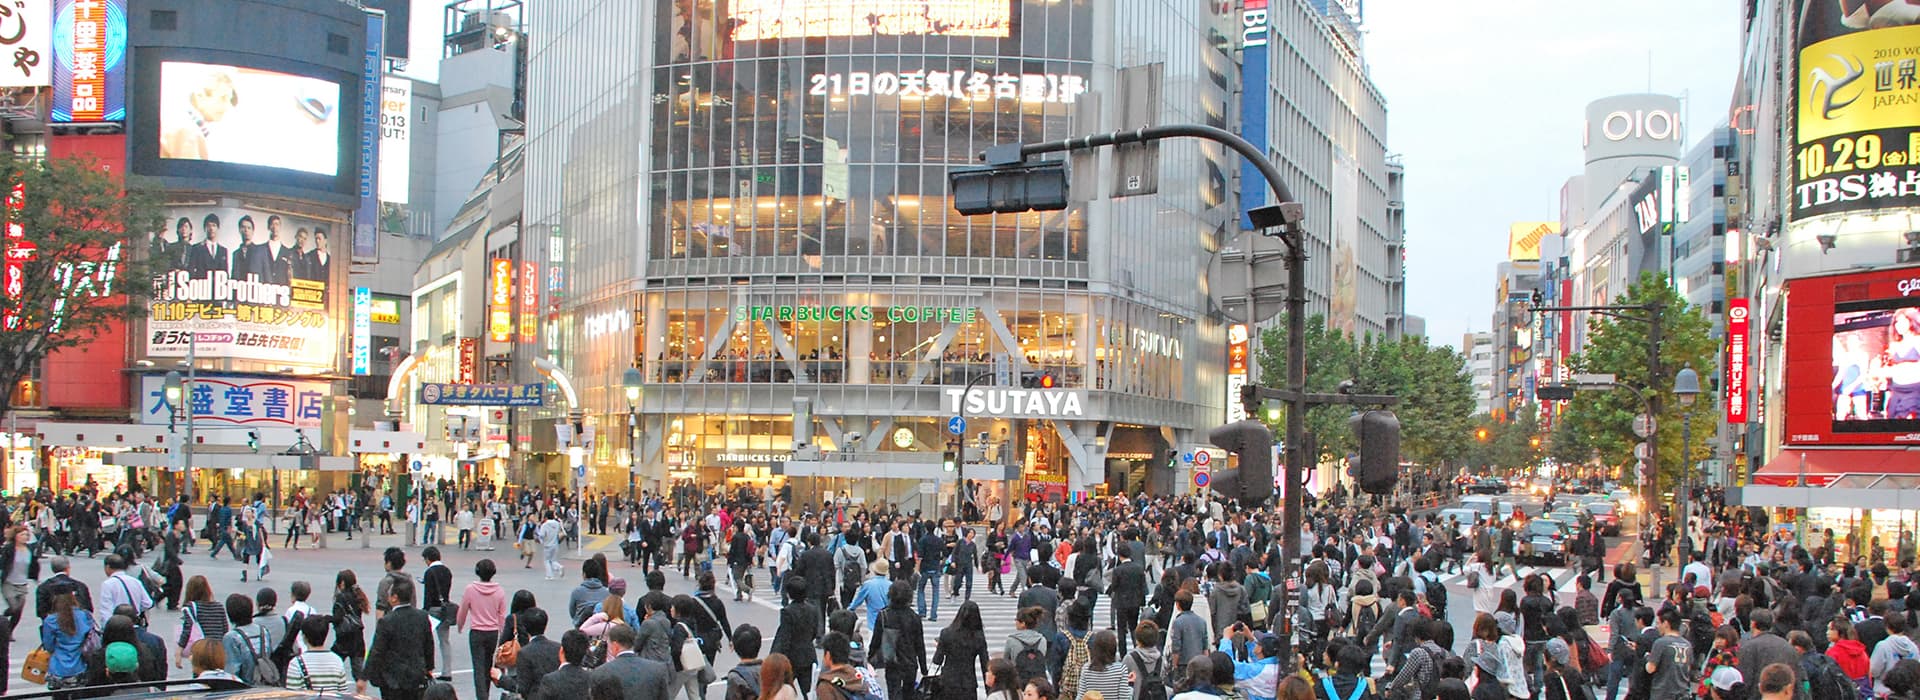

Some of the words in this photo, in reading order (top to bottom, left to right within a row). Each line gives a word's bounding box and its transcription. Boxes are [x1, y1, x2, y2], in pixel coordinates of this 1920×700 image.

[1873, 47, 1901, 60] 2010
[1874, 59, 1920, 92] 世界
[1873, 93, 1919, 110] JAPAN
[382, 128, 406, 140] UT!
[177, 270, 213, 301] Soul
[214, 270, 290, 306] Brothers
[735, 305, 873, 322] STARBUCKS
[888, 306, 976, 323] COFFEE
[150, 384, 323, 421] 大盛堂書店
[946, 389, 1083, 416] TSUTAYA
[716, 454, 771, 462] STARBUCKS
